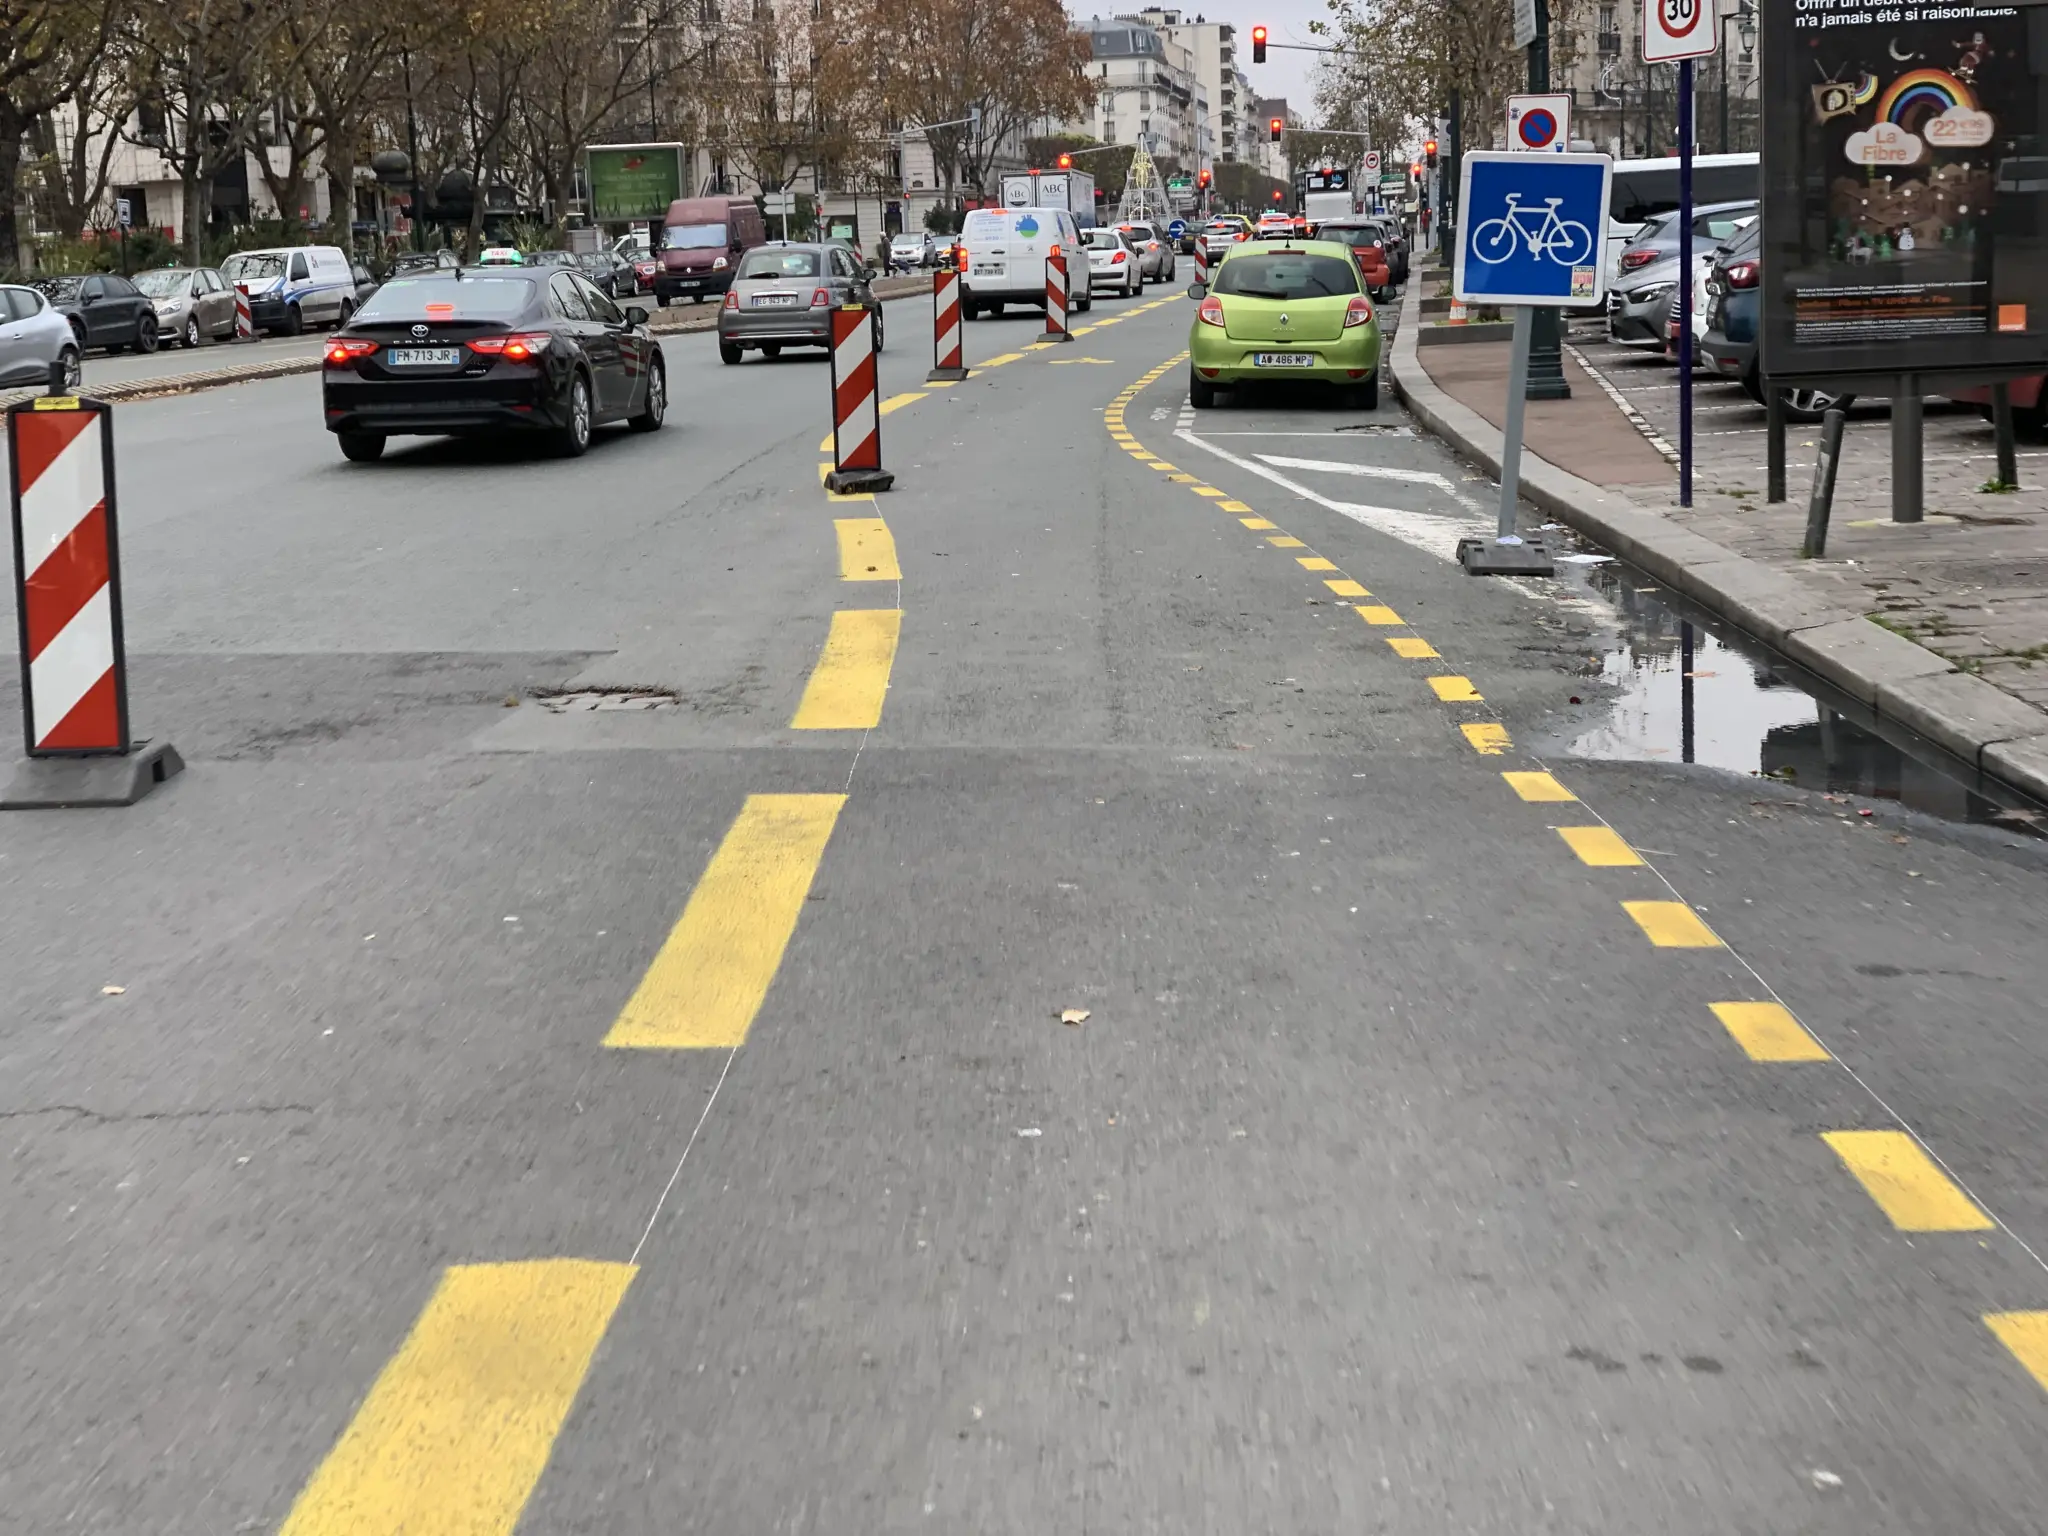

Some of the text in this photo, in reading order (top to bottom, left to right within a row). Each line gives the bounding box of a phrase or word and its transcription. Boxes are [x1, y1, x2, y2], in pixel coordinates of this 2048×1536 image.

[1666, 0, 1692, 21] 30
[1821, 10, 1873, 28] jamais
[1876, 8, 1901, 22] été
[1905, 7, 1918, 21] si
[1875, 129, 1897, 144] La
[1932, 119, 1957, 137] 22
[1862, 145, 1907, 161] Fibre
[1042, 183, 1066, 194] ABC
